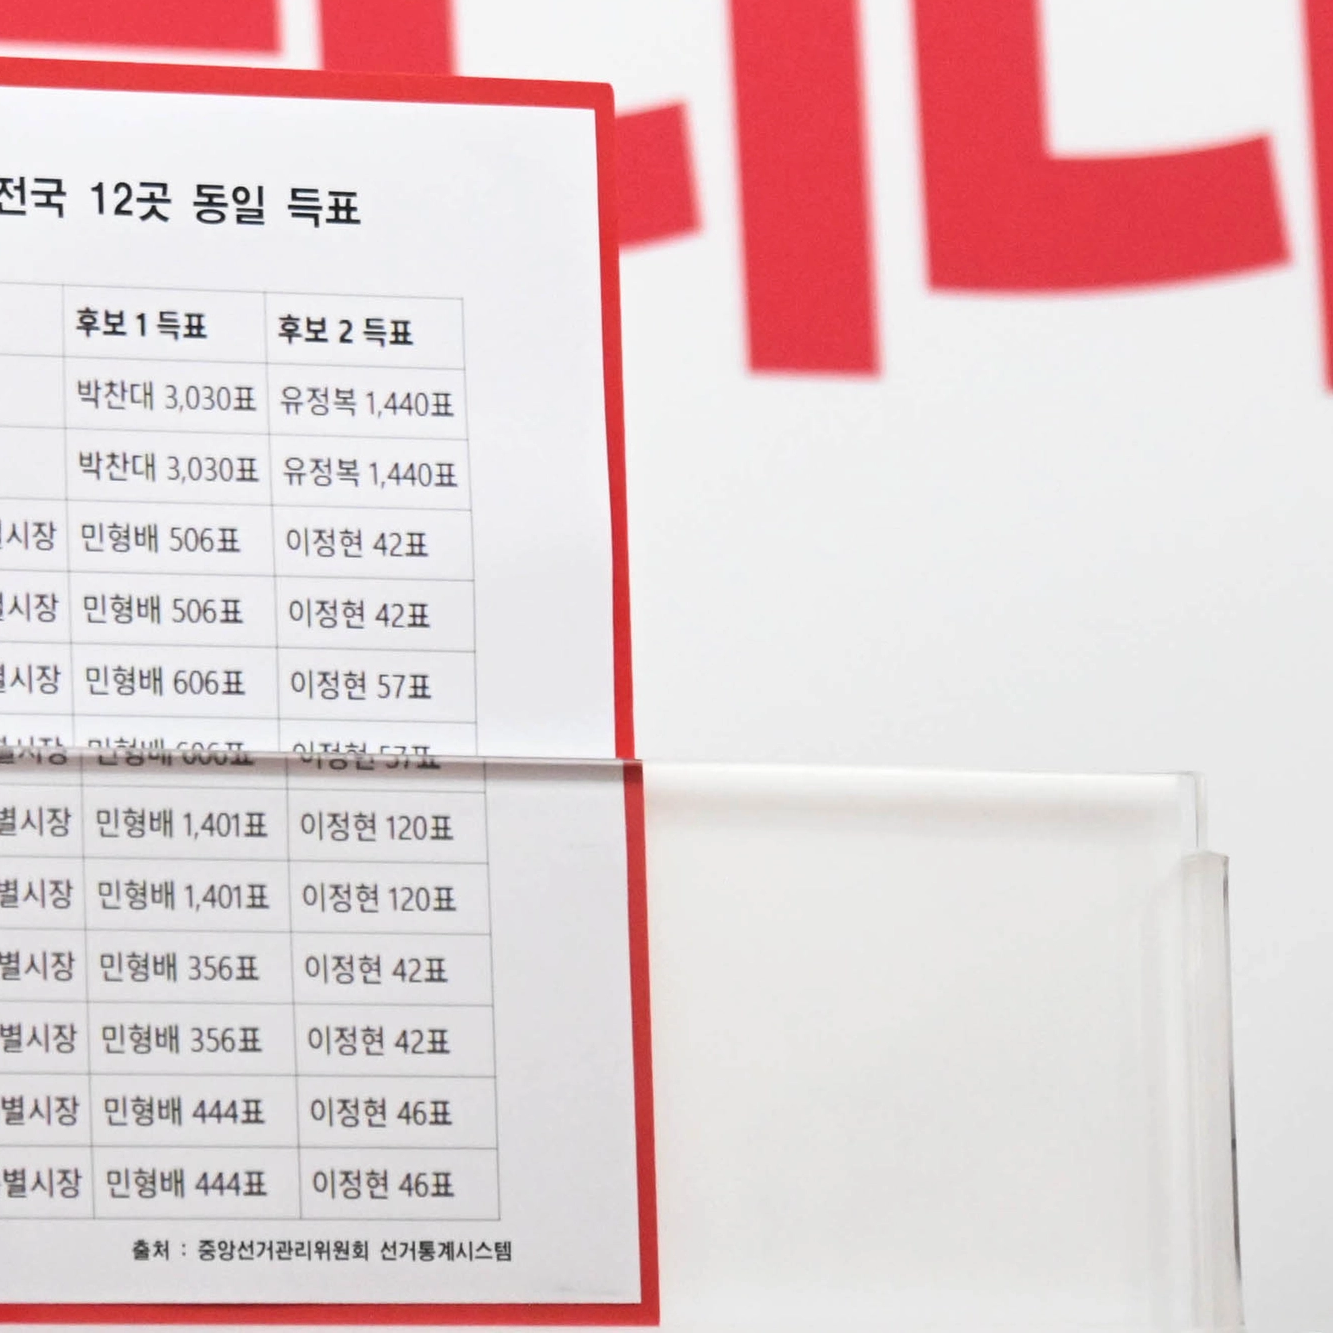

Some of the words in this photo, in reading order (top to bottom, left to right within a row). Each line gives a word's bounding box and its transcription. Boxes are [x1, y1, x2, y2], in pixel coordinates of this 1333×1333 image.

[90, 181, 173, 223] 12곳
[192, 183, 266, 226] 동일
[287, 187, 362, 229] 득표
[75, 306, 128, 338] 후보
[135, 312, 146, 337] 1
[156, 310, 208, 341] 득표
[277, 313, 329, 345] 후보
[338, 319, 354, 345] 2
[362, 317, 414, 348] 득표
[77, 379, 154, 411] 박찬대
[165, 384, 257, 412] 3,030표
[280, 386, 357, 417] 유정복
[366, 391, 455, 418] 1,440표
[79, 451, 156, 482] 박찬대
[167, 455, 260, 483] 3,030표
[283, 457, 360, 488] 유정복
[369, 461, 458, 489] 1,440표
[81, 522, 159, 554] 민형배
[170, 526, 241, 553] 506표
[286, 527, 363, 559] 이정현
[372, 532, 429, 558] 42표
[83, 593, 161, 625] 민형배
[172, 598, 244, 625] 506표
[289, 598, 365, 630] 이정현
[374, 602, 431, 629] 42표
[85, 665, 163, 697] 민형배
[173, 669, 246, 696] 606표
[290, 669, 366, 701] 이정현
[377, 673, 432, 700] 57표
[96, 807, 173, 839] 민형배
[183, 811, 268, 840] 1,401표
[300, 811, 376, 842] 이정현
[386, 815, 454, 841] 120표
[98, 879, 175, 911] 민형배
[185, 883, 270, 911] 1,401표
[302, 882, 379, 914] 이정현
[389, 886, 457, 912] 120표
[100, 951, 177, 983] 민형배
[189, 955, 260, 981] 356표
[305, 954, 382, 985] 이정현
[392, 957, 449, 984] 42표
[102, 1023, 180, 1055] 민형배
[191, 1026, 263, 1053] 356표
[308, 1025, 384, 1056] 이정현
[394, 1028, 451, 1055] 42표
[104, 1095, 182, 1127] 민형배
[192, 1098, 266, 1125] 444표
[310, 1097, 387, 1128] 이정현
[396, 1100, 453, 1126] 46표
[106, 1167, 185, 1199] 민형배
[195, 1170, 268, 1197] 444표
[312, 1169, 388, 1200] 이정현
[398, 1171, 455, 1198] 46표
[132, 1238, 170, 1261] 출처
[197, 1239, 369, 1262] 중앙선거관리위원회
[380, 1240, 512, 1262] 선거통계시스템
